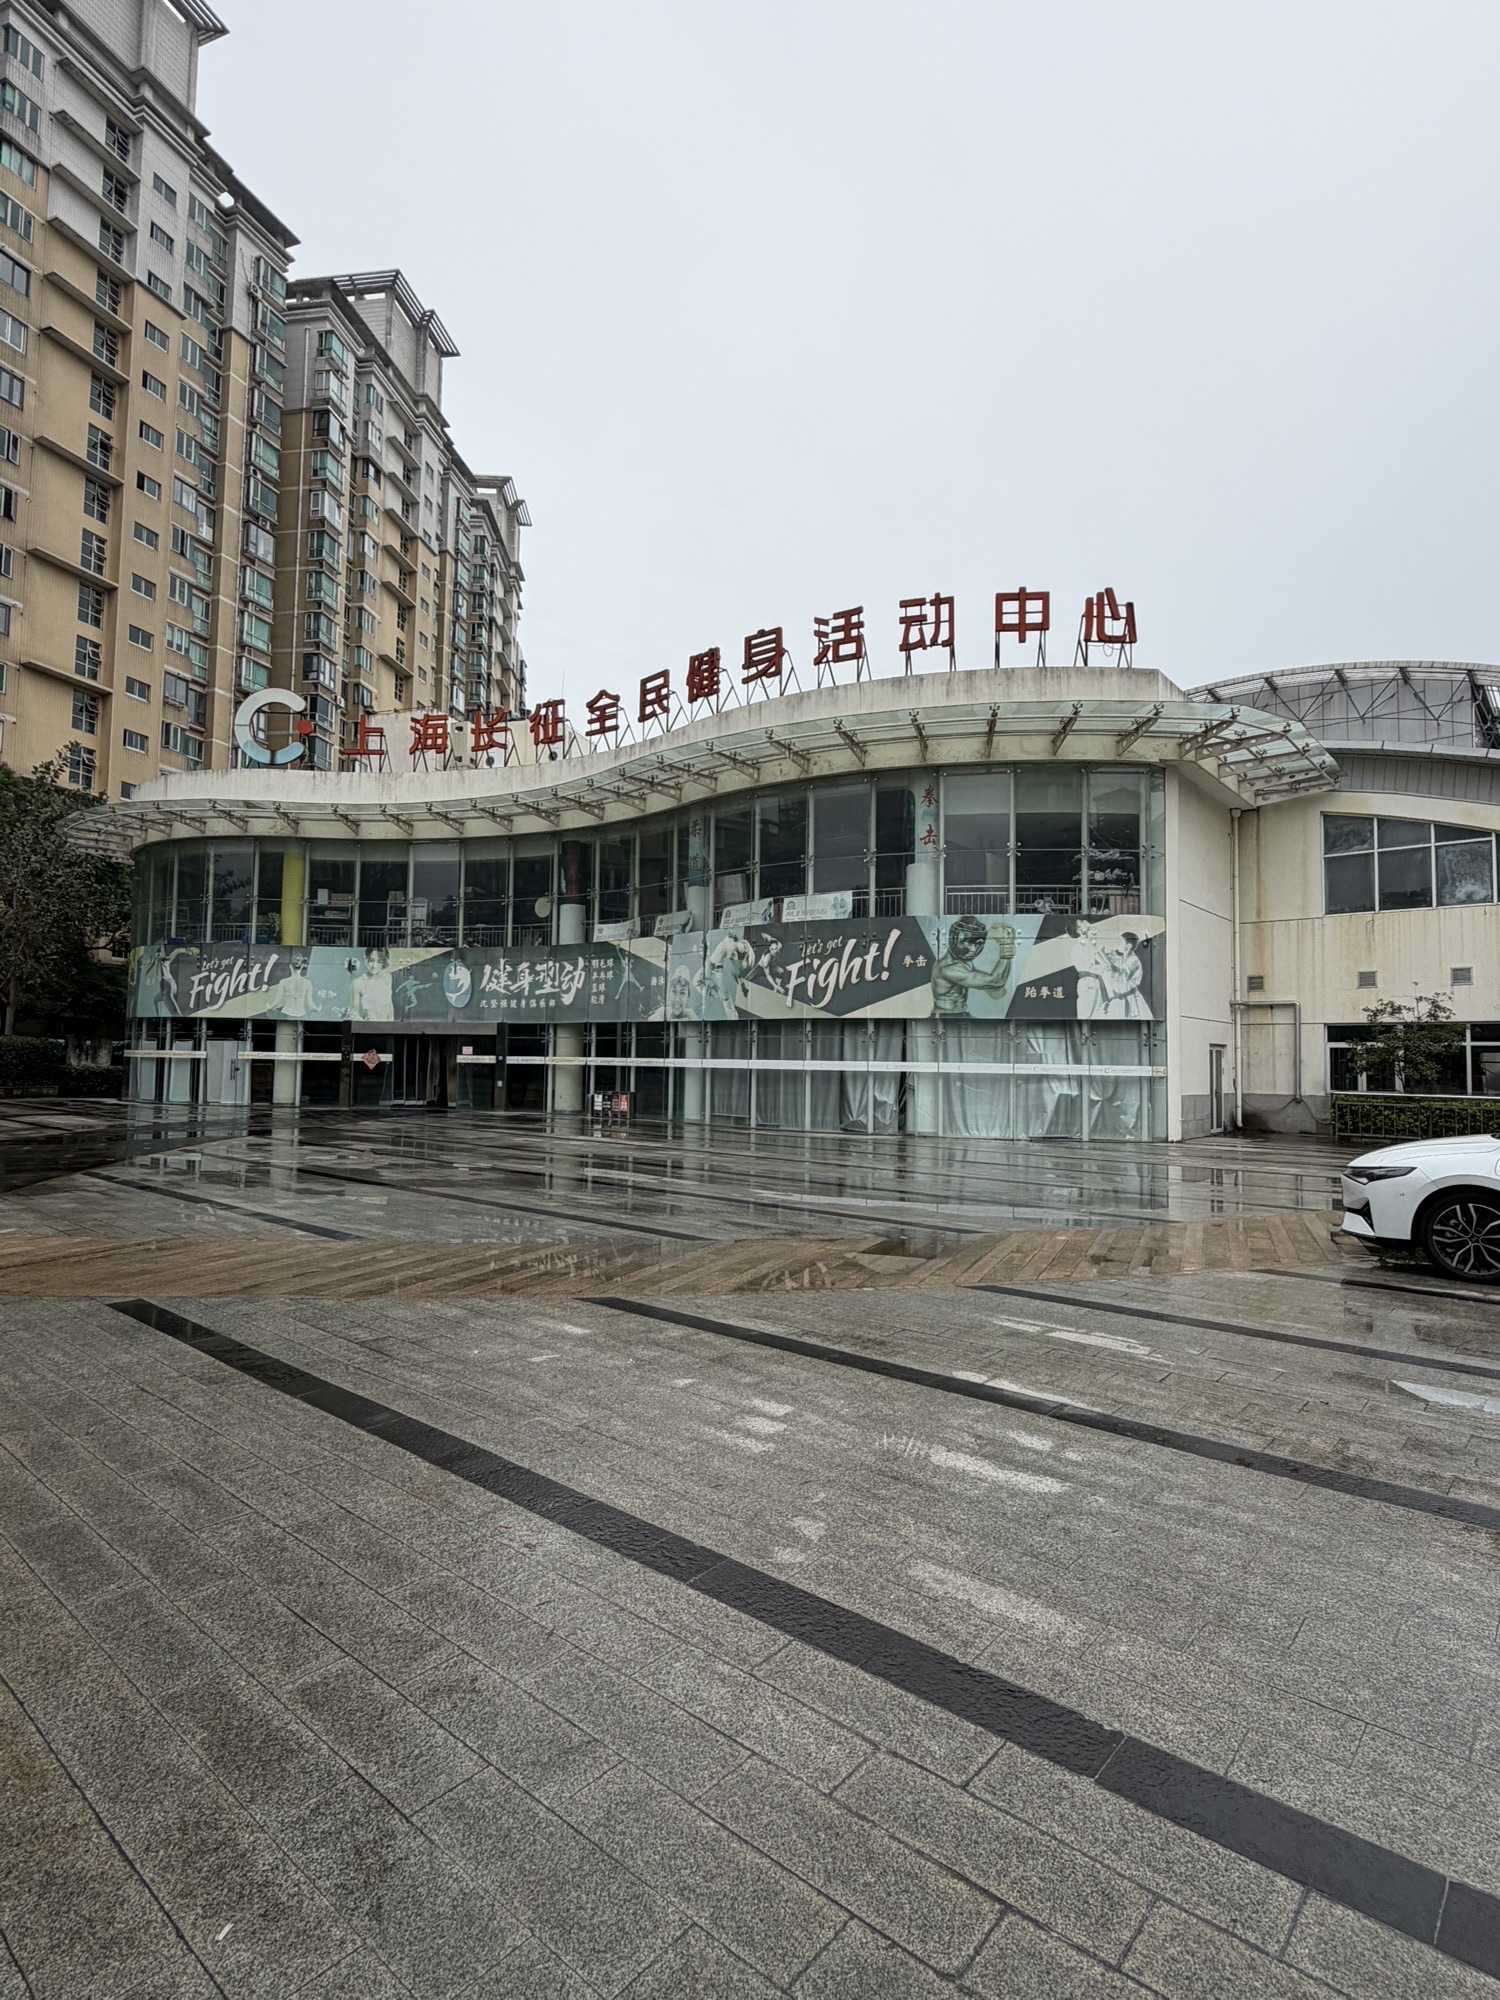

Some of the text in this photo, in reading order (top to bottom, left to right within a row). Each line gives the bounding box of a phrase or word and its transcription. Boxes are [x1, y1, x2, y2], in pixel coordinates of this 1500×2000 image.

[343, 586, 1138, 755] 上海长征全民健身活动中心
[919, 784, 939, 846] 拳击
[220, 955, 235, 970] get
[825, 935, 844, 956] get
[902, 954, 928, 968] 拳击
[189, 953, 280, 1010] Fight!
[785, 928, 902, 1008] Fight!
[1024, 985, 1066, 999] 跆拳道
